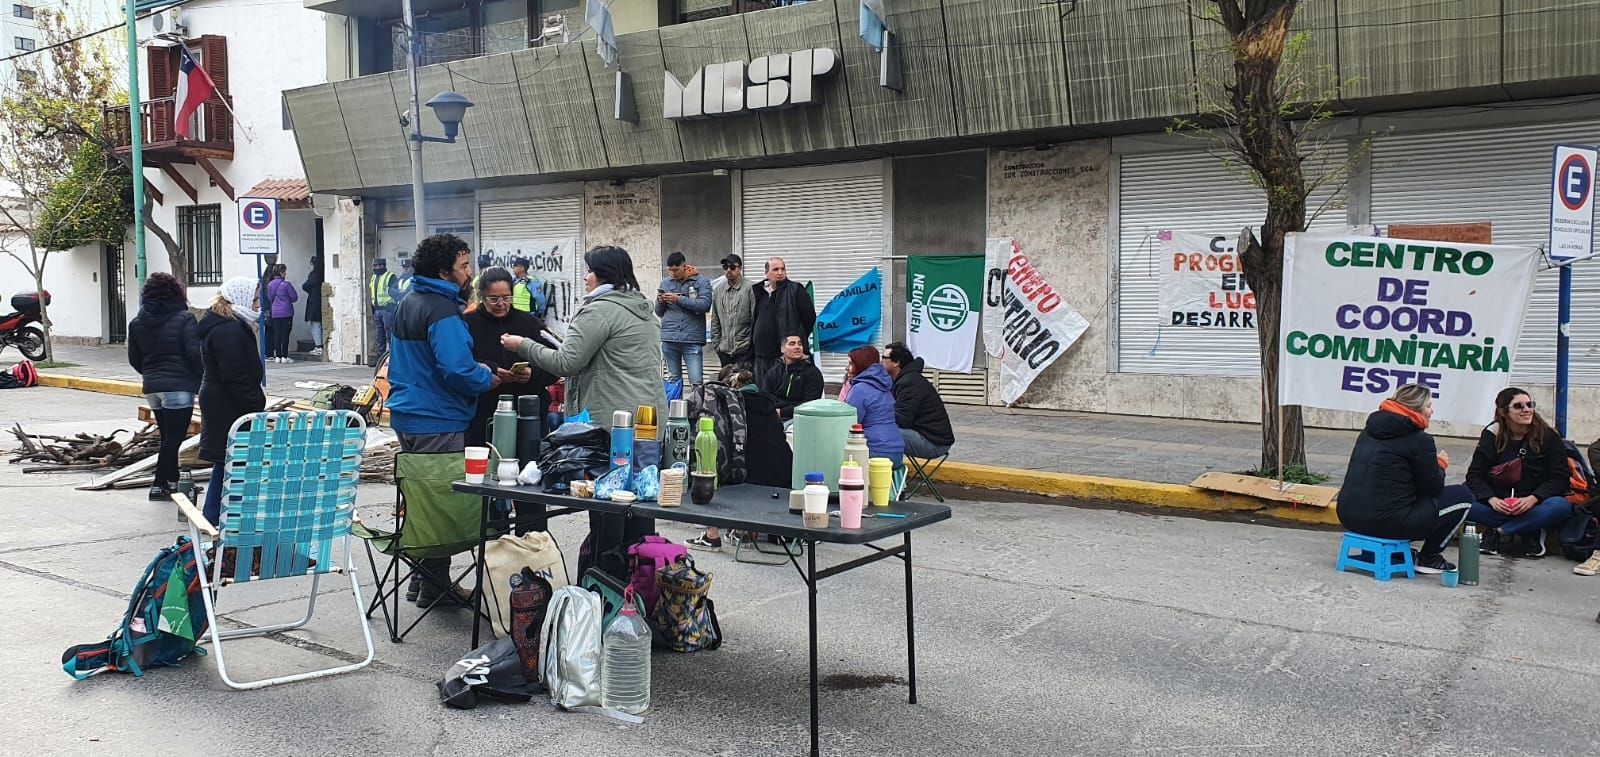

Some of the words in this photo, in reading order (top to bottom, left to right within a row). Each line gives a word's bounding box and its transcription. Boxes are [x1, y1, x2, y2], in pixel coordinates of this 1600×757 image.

[1566, 165, 1583, 199] E
[250, 207, 265, 224] E
[1325, 241, 1494, 276] CENTRO
[1377, 276, 1430, 306] DE
[852, 315, 867, 326] DE
[928, 287, 967, 330] ATE
[1336, 304, 1477, 338] COORD.
[1341, 365, 1442, 399] ESTE
